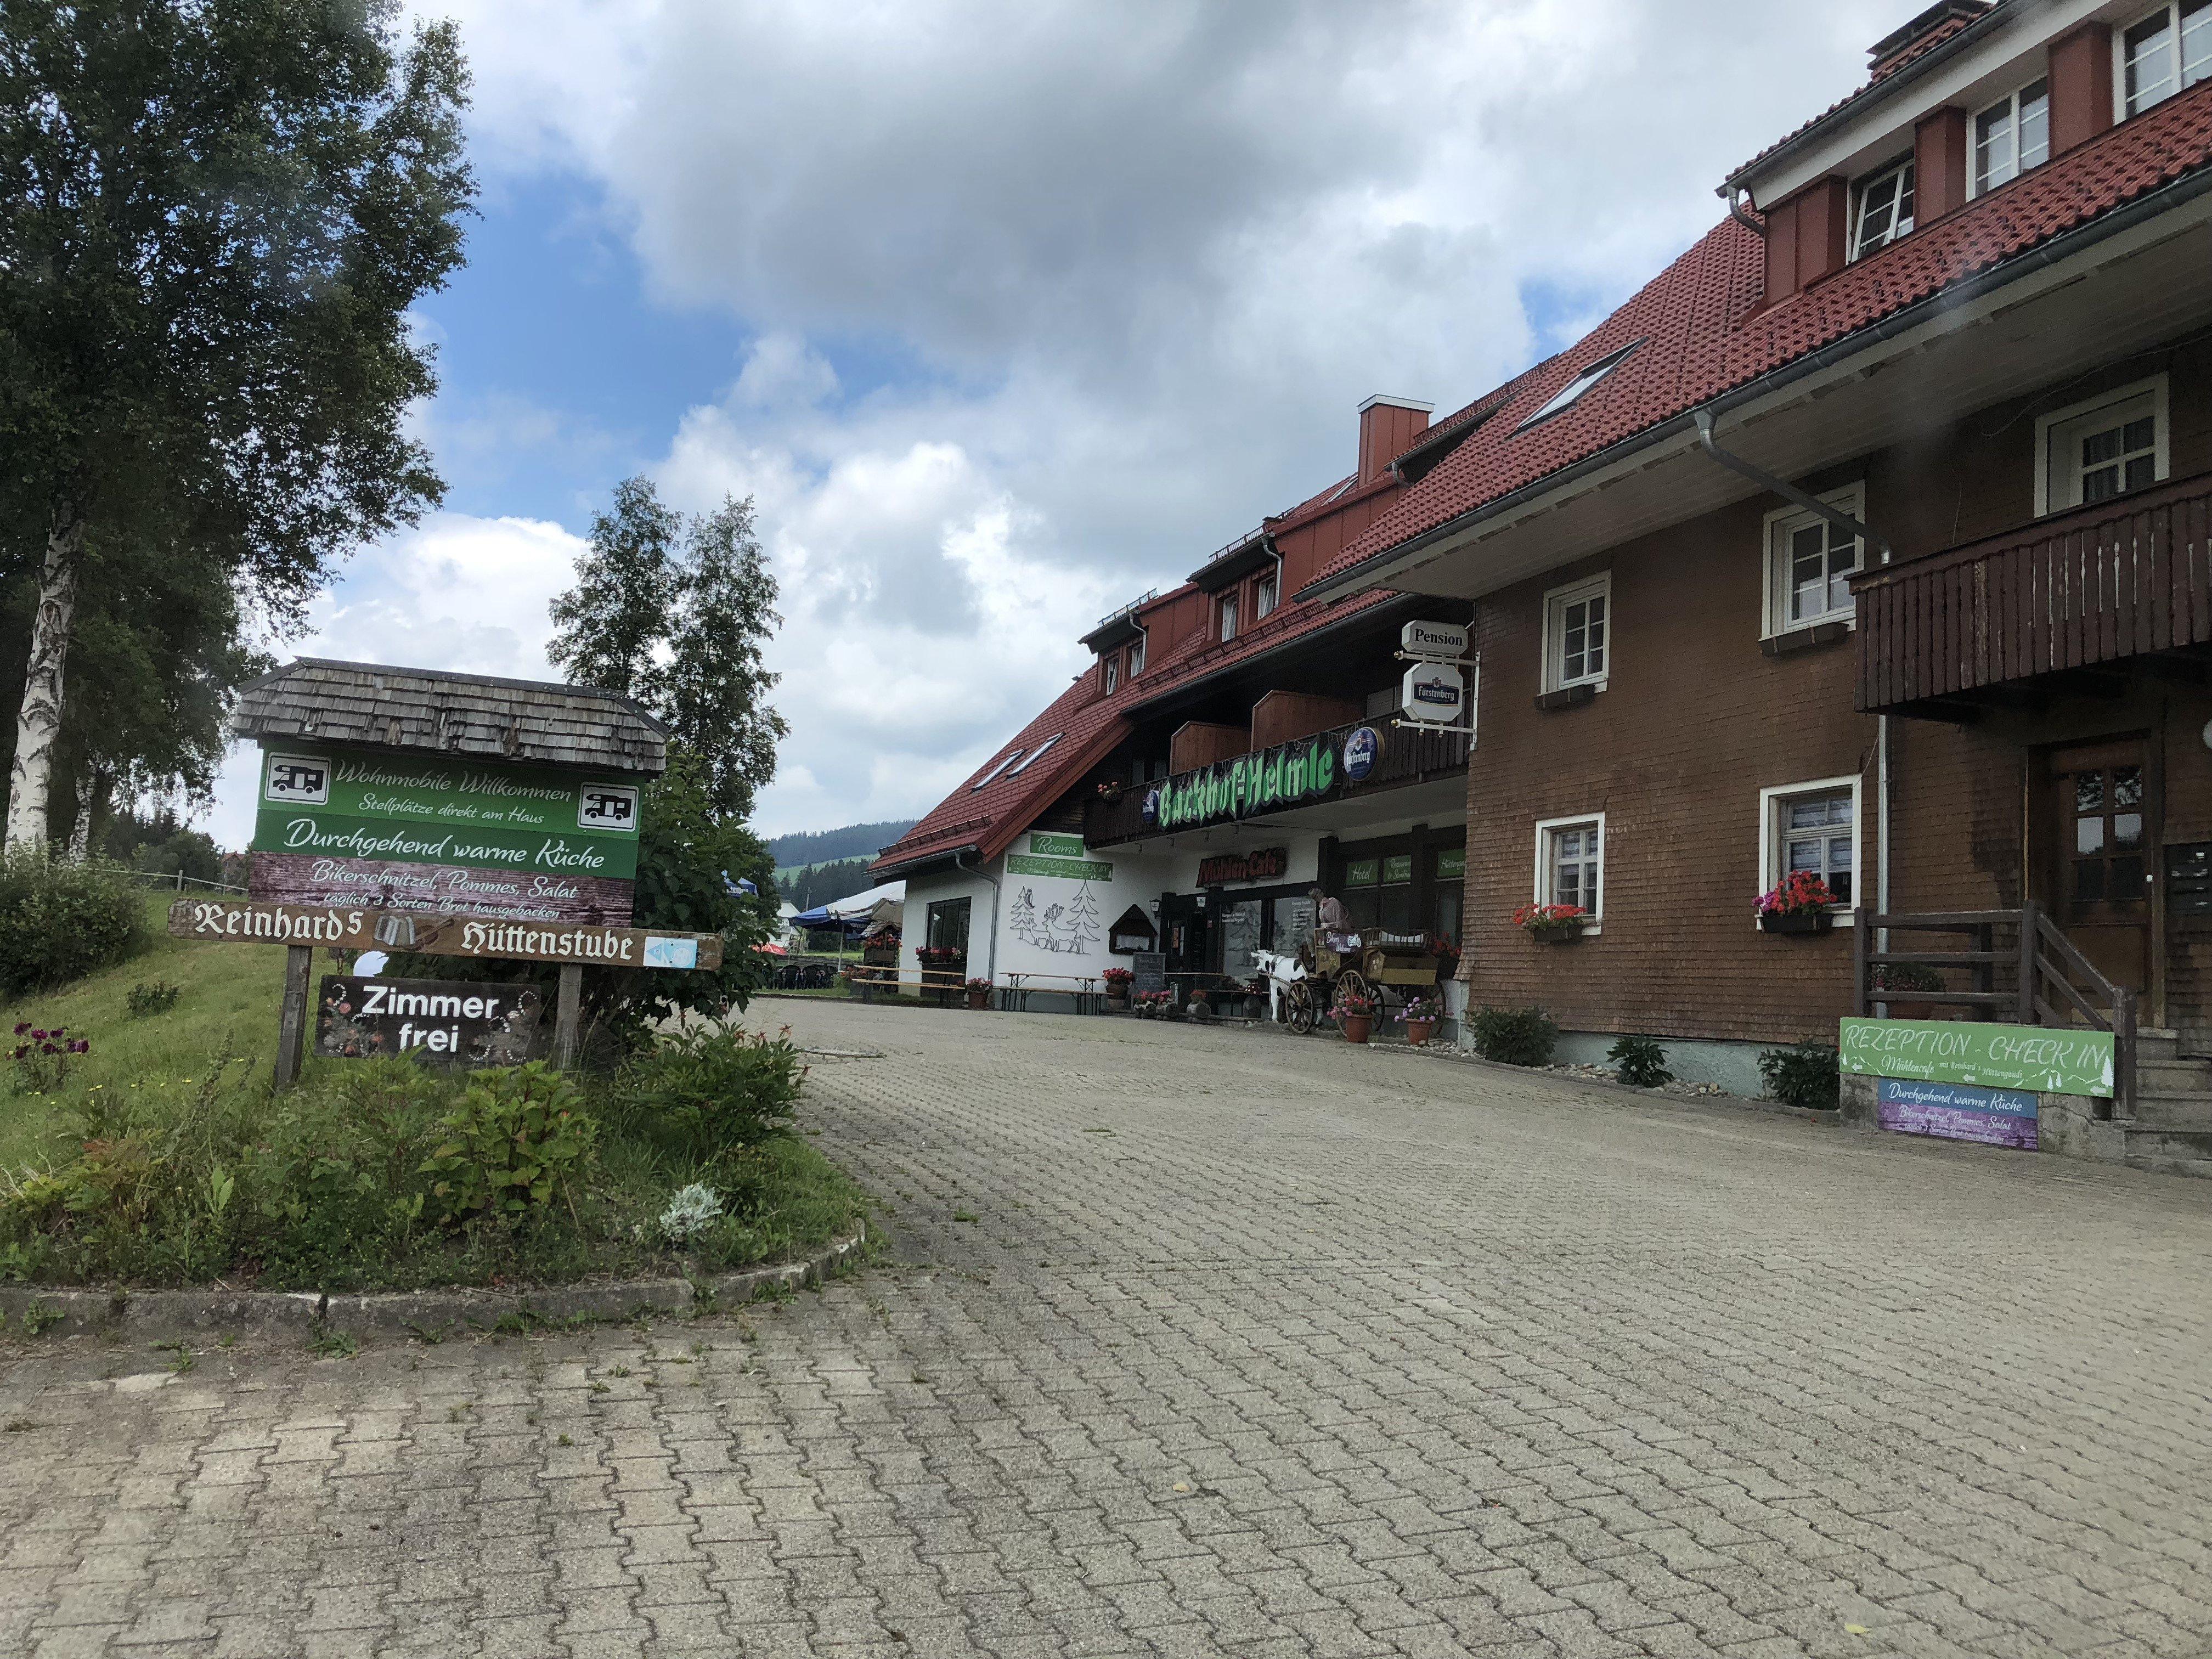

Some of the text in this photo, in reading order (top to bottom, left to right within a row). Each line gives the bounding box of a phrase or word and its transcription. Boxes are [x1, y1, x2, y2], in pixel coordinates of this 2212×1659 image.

[1414, 628, 1463, 646] Pension
[1419, 686, 1455, 701] Fürstenberg
[335, 759, 573, 803] Wohnmobile Willkommen
[1159, 741, 1334, 827] Backhof-Helmle
[358, 793, 544, 824] Stellplätze direkt am Haus
[284, 819, 605, 869] Durchgehend warme Küche
[1037, 836, 1077, 855] Rooms
[309, 860, 578, 899] Bikerschnitzel, Pommes, Salat
[1010, 856, 1064, 869] REZEPTION
[1069, 862, 1096, 873] CHECK
[1352, 864, 1372, 882] Hotel
[324, 891, 560, 919] täglich 3 Sorten Brot hausgebacken
[194, 903, 634, 961] Reinhards Hüttenstube
[362, 985, 500, 1019] Zimmer
[398, 1023, 459, 1053] frei
[1846, 1025, 1972, 1056] REZEPTION
[1989, 1036, 2074, 1069] CHECK
[2076, 1043, 2108, 1070] IN
[1888, 1082, 2023, 1113] Durchgehend warme Küche
[1988, 1115, 2012, 1130] Salat
